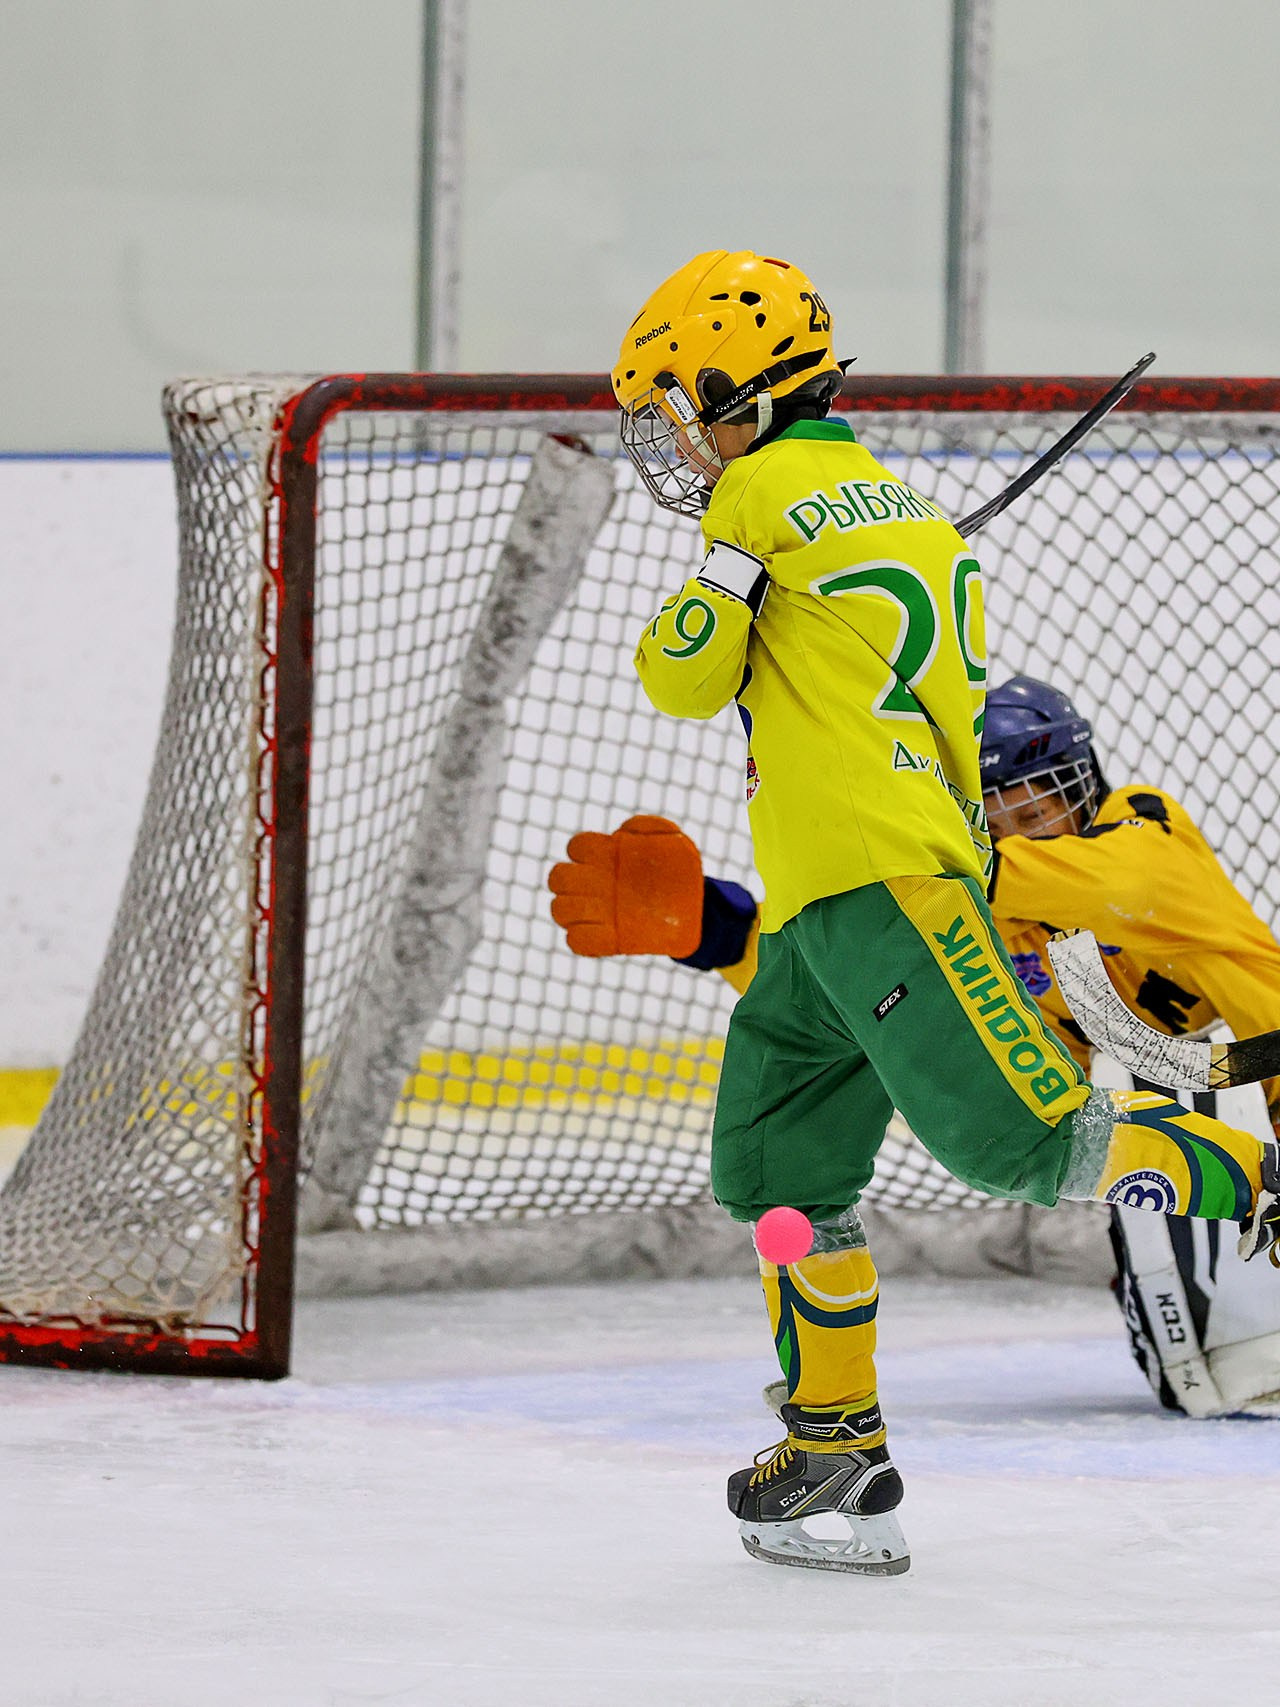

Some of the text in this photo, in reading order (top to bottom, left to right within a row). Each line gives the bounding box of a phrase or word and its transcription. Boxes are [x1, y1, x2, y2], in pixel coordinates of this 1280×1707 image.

[800, 291, 831, 333] 29
[634, 320, 672, 350] Reebok
[787, 480, 951, 543] РЫБЯК
[878, 988, 901, 1016] STEX
[931, 914, 1070, 1107] ВОДНИК
[1109, 1172, 1169, 1197] АРХАНГЕЛЬСК
[1155, 1292, 1187, 1344] CCM
[779, 1485, 807, 1508] CCM
